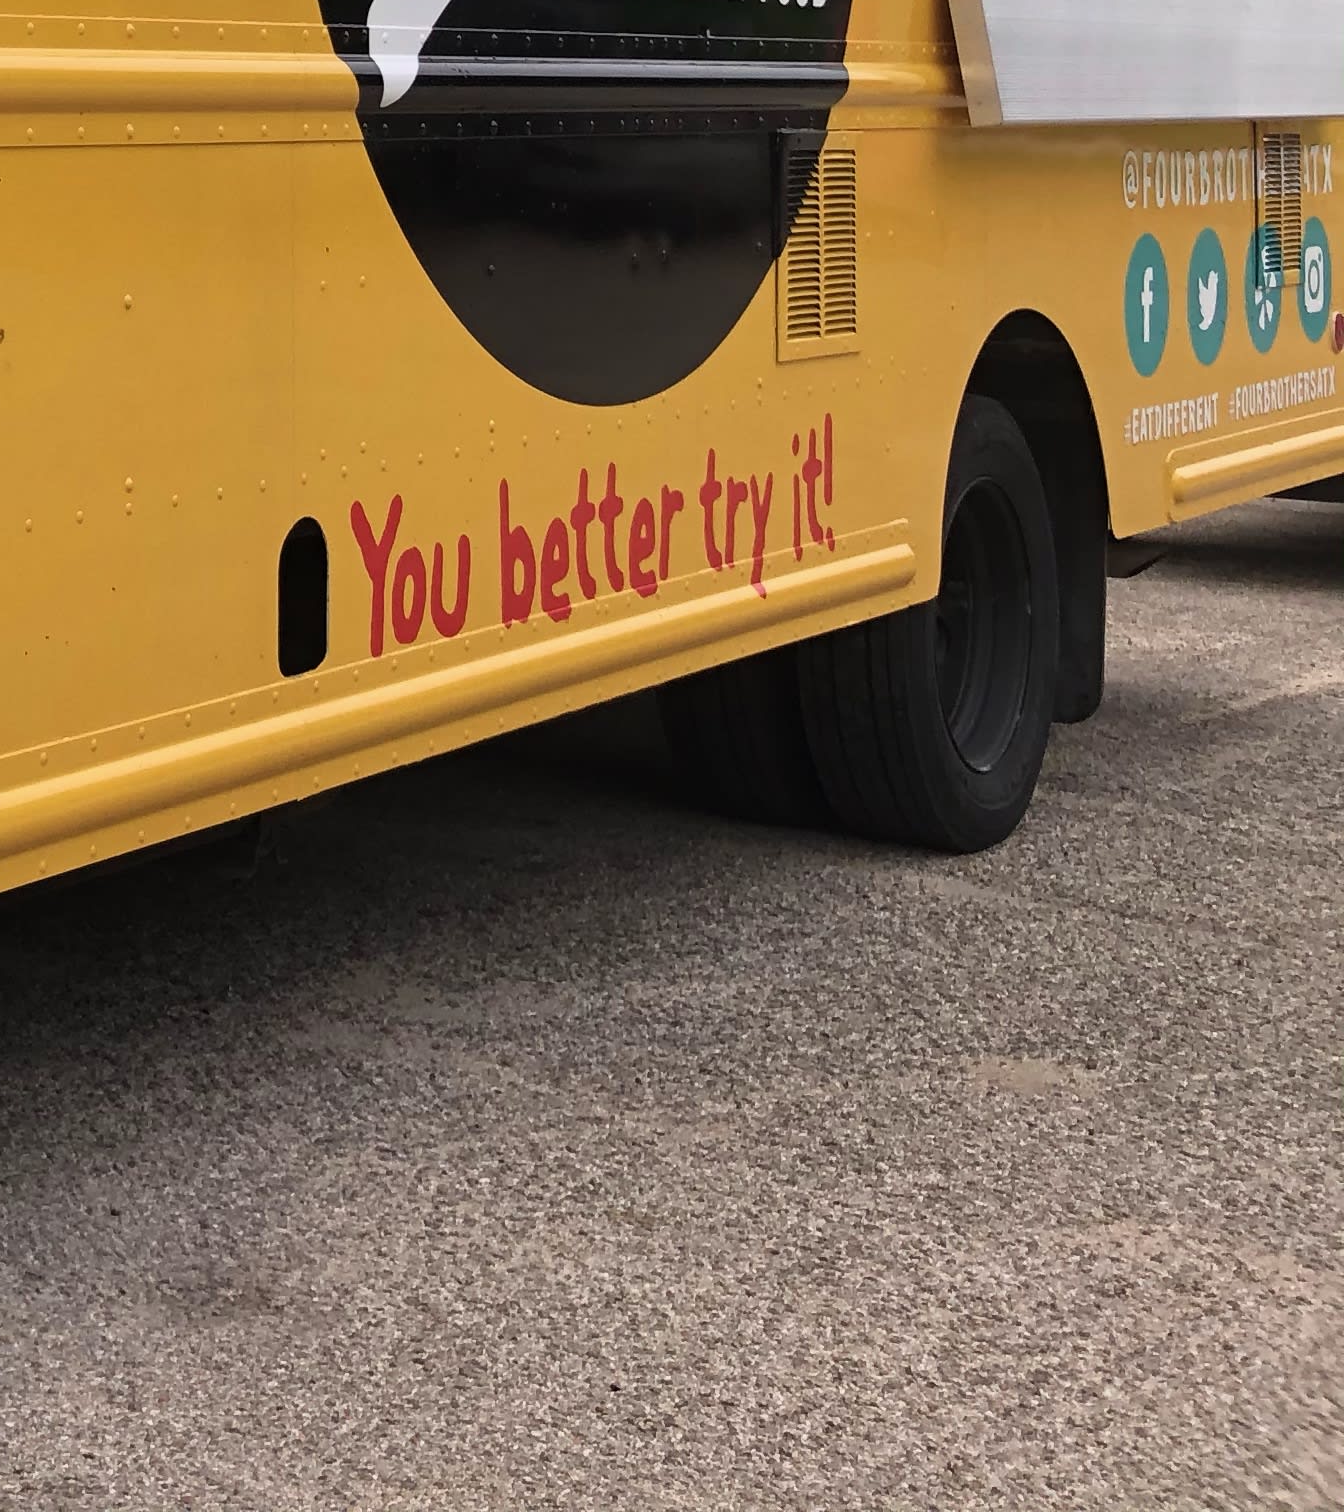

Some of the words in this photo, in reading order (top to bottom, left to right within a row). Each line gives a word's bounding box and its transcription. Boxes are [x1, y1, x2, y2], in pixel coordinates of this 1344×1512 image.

[1124, 392, 1219, 445] #EATDIFFERENT
[1228, 365, 1336, 421] #FOURBROTHERSATX
[350, 494, 471, 658] You
[499, 461, 684, 629] better
[699, 447, 774, 599] try
[791, 412, 836, 562] it!
